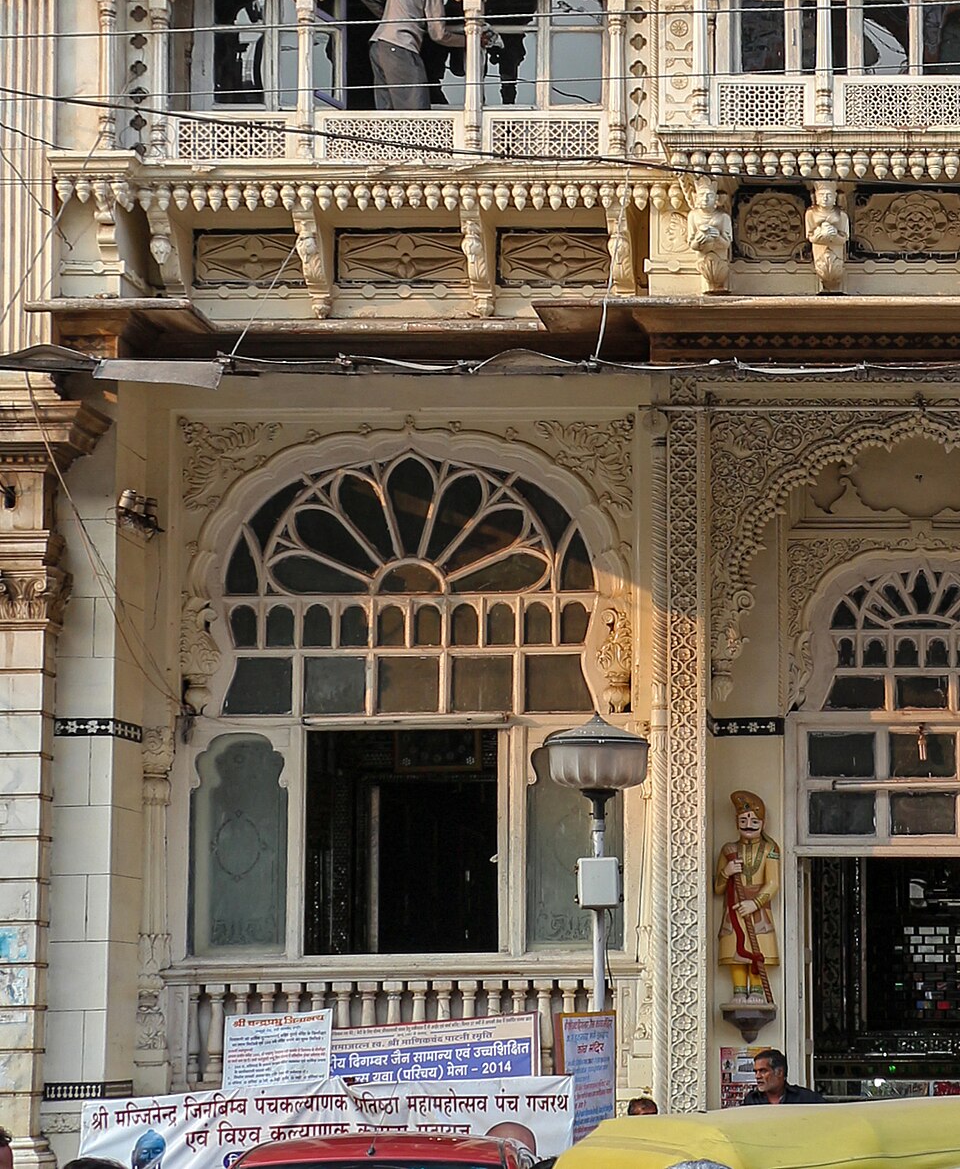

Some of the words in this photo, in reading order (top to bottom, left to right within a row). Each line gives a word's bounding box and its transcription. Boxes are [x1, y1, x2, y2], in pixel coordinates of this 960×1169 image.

[348, 1052, 388, 1068] दिगम्बर
[391, 1049, 410, 1065] जैन
[413, 1048, 452, 1063] सामान्य
[455, 1043, 471, 1061] एवं
[473, 1040, 530, 1058] उच्चशिक्षित
[388, 1036, 399, 1047] श्री
[397, 1063, 444, 1081] (परिचय)
[447, 1061, 468, 1076] मेला
[482, 1061, 512, 1074] 2014
[92, 1105, 109, 1130] श्री
[114, 1100, 177, 1127] मज्जिनेन्द्र
[184, 1093, 247, 1121] जिनबिम्ब
[254, 1090, 348, 1114] पंचकल्याणक
[353, 1091, 400, 1115] प्रतिष्ठा
[406, 1088, 488, 1116] महामहोत्सव
[495, 1088, 519, 1112] पंच
[526, 1094, 569, 1113] गजरथ
[185, 1123, 210, 1153] एवं
[217, 1121, 262, 1147] विश्व
